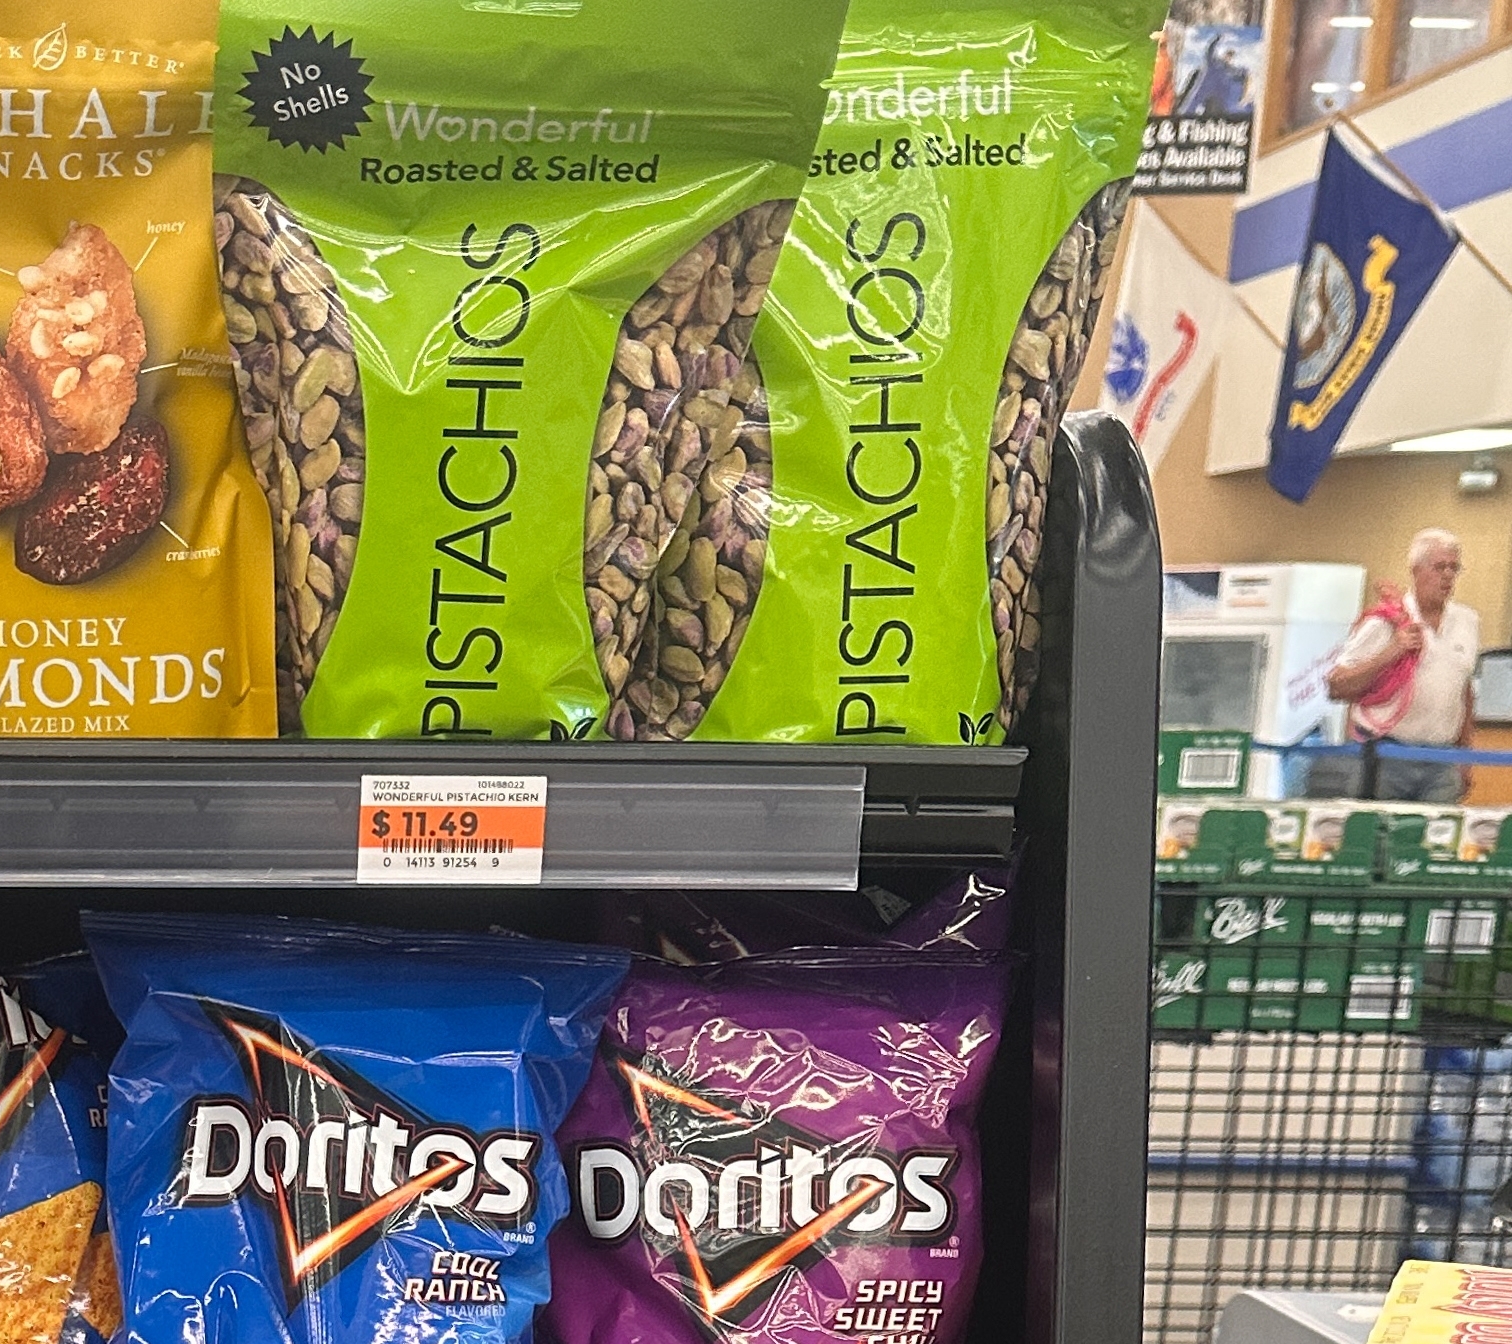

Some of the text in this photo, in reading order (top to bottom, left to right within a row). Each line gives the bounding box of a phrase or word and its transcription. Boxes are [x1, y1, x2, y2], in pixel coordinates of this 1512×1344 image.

[280, 62, 321, 89] No
[273, 83, 349, 123] Shells
[384, 99, 652, 145] Wonderful
[360, 154, 659, 186] Roasted & Salted
[422, 221, 541, 737] PISTACHIOS
[838, 211, 926, 736] PISTACHIOS
[373, 792, 538, 802] WONDERFUL PISTACHIO KERN
[372, 810, 478, 838] $ 11.49
[407, 857, 435, 867] 14113
[443, 857, 477, 867] 91254
[189, 1105, 533, 1214] Doritos
[580, 1145, 949, 1239] Doritos
[431, 1251, 499, 1281] COOL
[405, 1278, 506, 1302] RANCH
[855, 1280, 943, 1303] SPICY
[833, 1307, 942, 1331] SWEET
